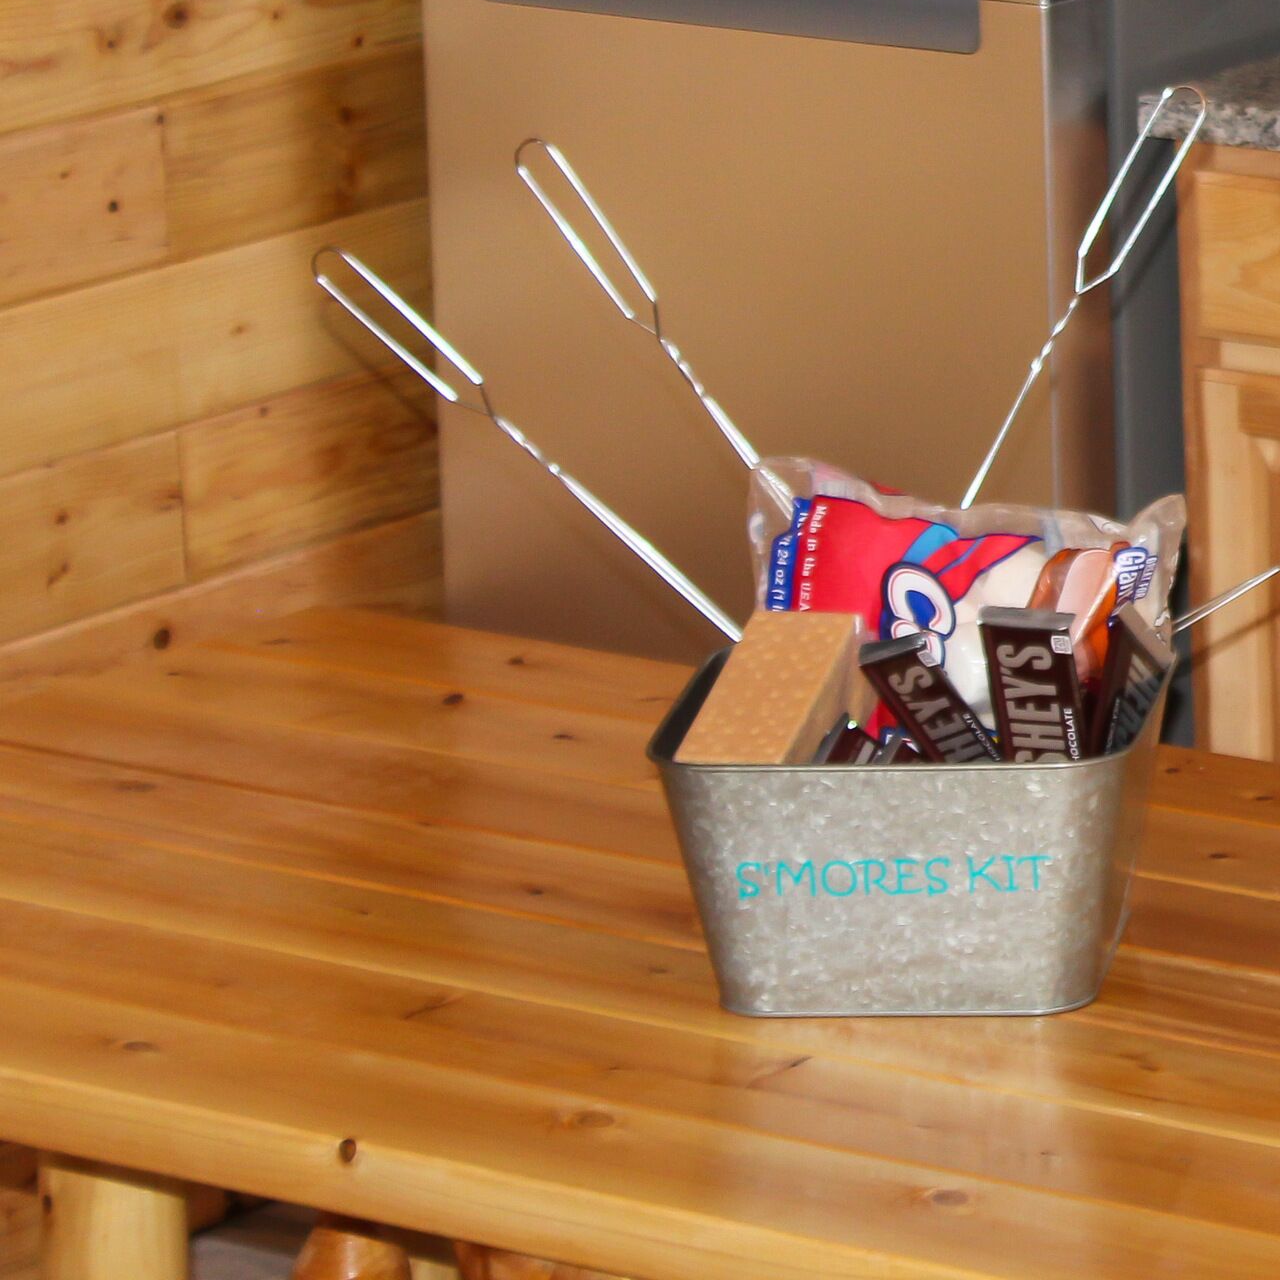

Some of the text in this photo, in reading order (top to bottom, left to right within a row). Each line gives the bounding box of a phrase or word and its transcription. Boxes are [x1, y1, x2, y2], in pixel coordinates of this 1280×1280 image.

[809, 505, 828, 534] Made
[774, 569, 785, 586] oz
[802, 557, 816, 577] the
[735, 853, 1053, 901] S'MORES KIT
